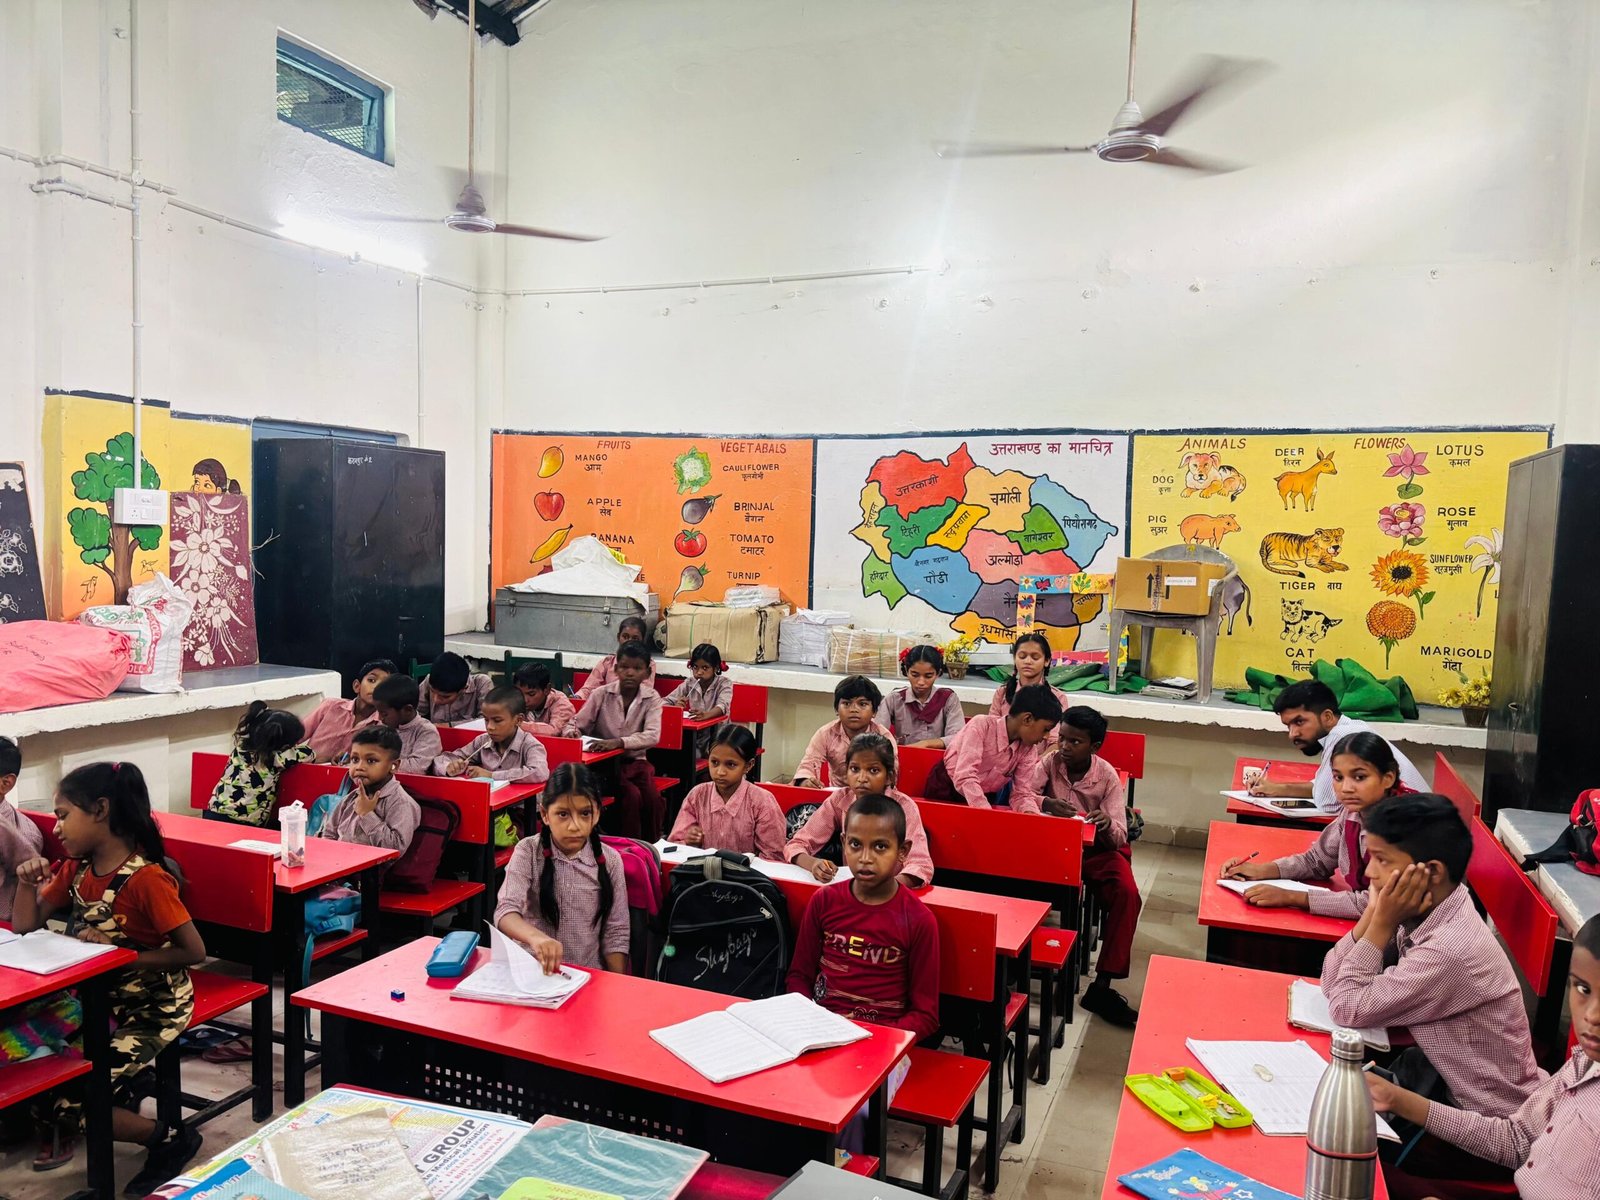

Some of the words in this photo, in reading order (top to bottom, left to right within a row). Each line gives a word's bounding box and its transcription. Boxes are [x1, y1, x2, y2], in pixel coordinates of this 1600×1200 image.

[597, 440, 631, 450] FRUITS
[720, 442, 787, 454] VEGETABALS
[989, 443, 1042, 456] उत्तराखण्ड
[1047, 443, 1061, 454] का
[1069, 438, 1113, 456] मानचित्र
[1176, 438, 1247, 452] ANIMALS
[1354, 437, 1406, 450] FLOWERS
[1275, 448, 1305, 456] DEER
[1436, 444, 1484, 457] LOTUS
[575, 453, 608, 461] MANGO
[1448, 459, 1471, 468] कमल
[1152, 475, 1174, 484] DOG
[989, 486, 1022, 506] चमोली
[587, 498, 622, 507] APPLE
[734, 502, 775, 511] BRINJAL
[599, 506, 612, 516] सेब
[1437, 507, 1476, 517] ROSE
[1148, 515, 1167, 523] PIG
[730, 533, 775, 544] TOMATO
[740, 546, 766, 556] टमाटर
[1429, 554, 1473, 564] SUNFLOWER
[727, 571, 761, 580] TURNIP
[1279, 581, 1315, 590] TIGER
[1285, 647, 1315, 658] CAT
[1420, 646, 1492, 659] MARIGOLD
[423, 1119, 476, 1164] GROUP
[432, 1149, 461, 1173] Medical
[460, 1123, 489, 1149] Solution
